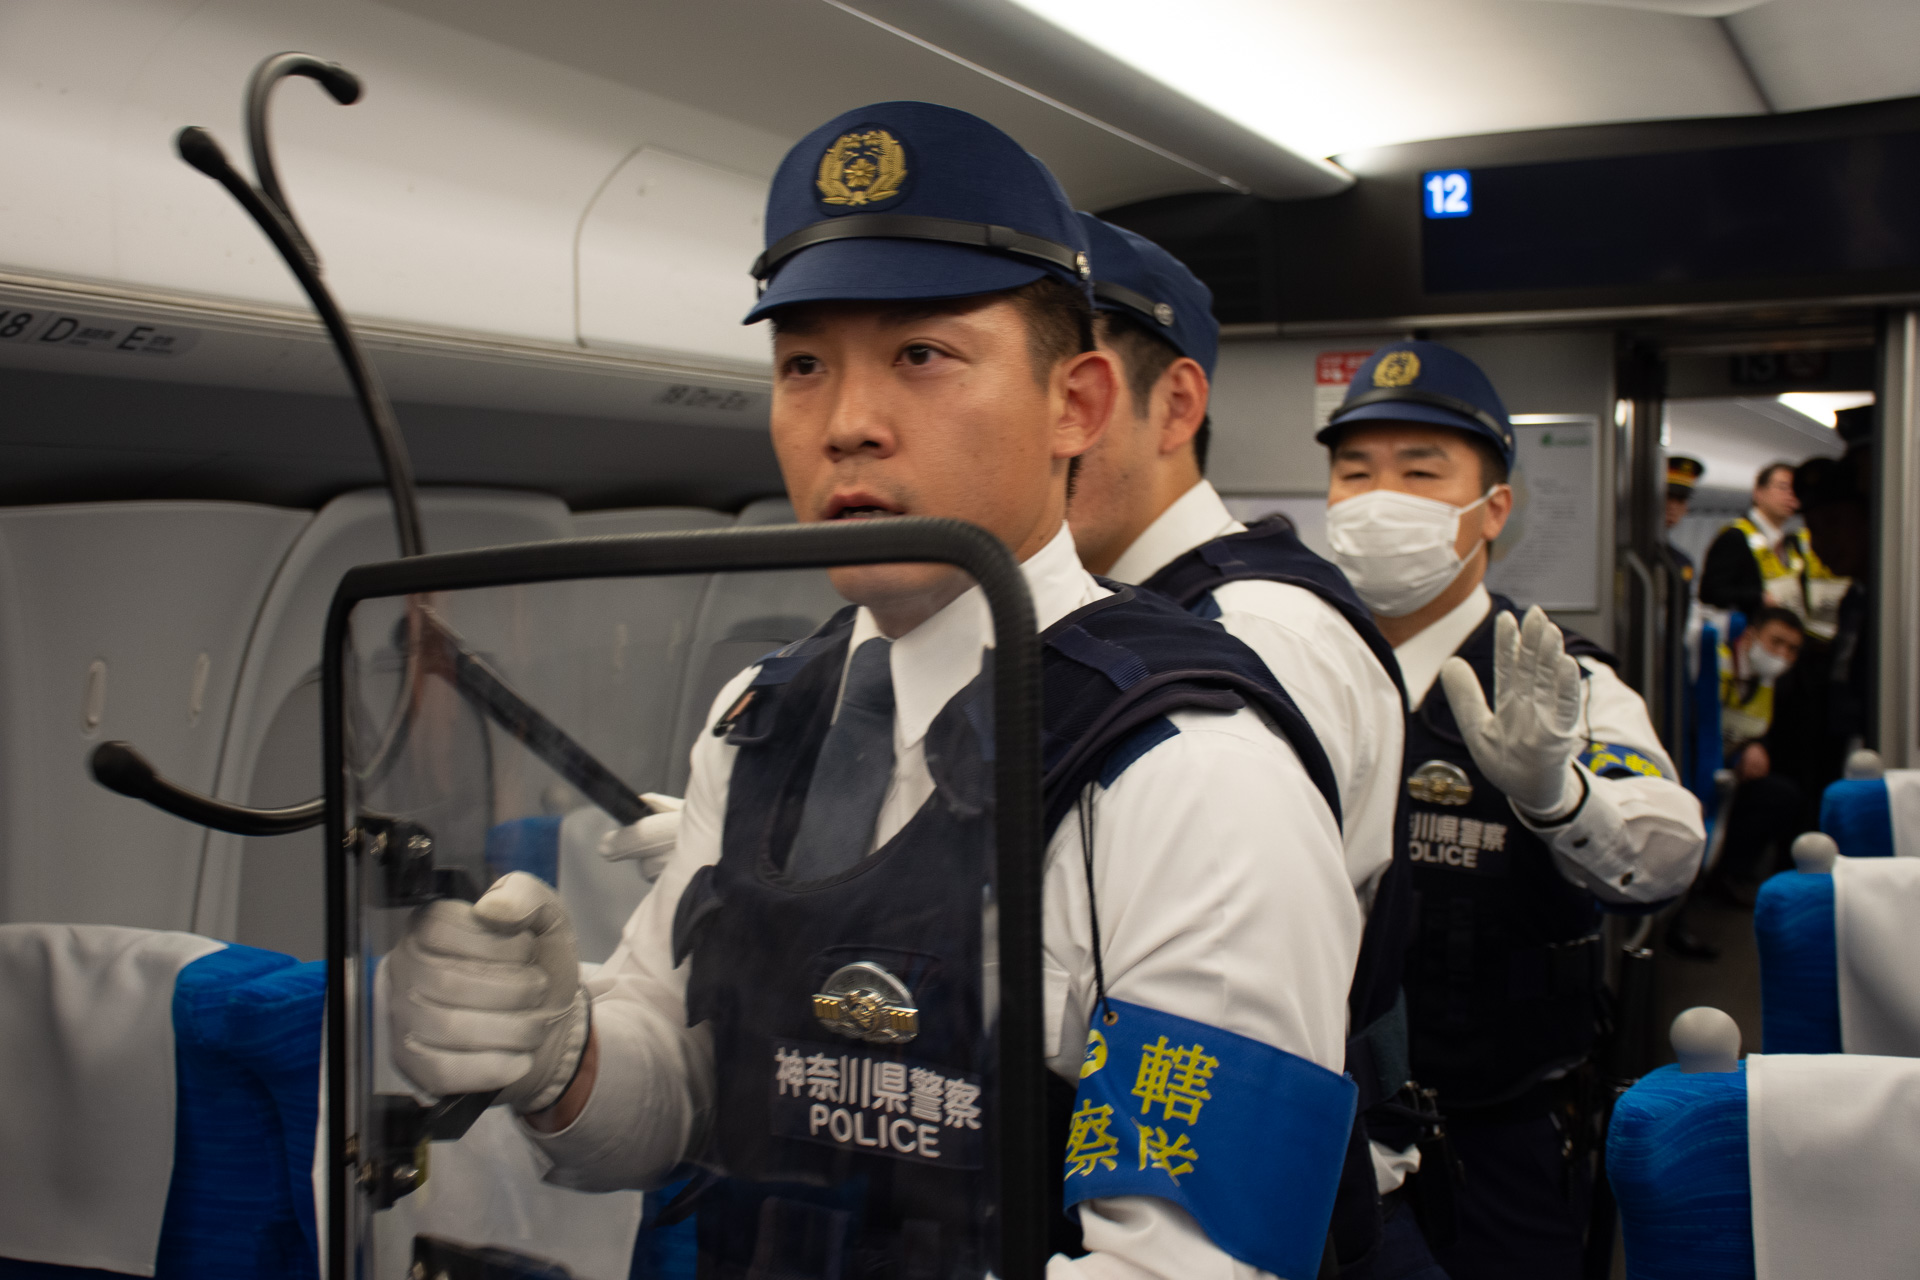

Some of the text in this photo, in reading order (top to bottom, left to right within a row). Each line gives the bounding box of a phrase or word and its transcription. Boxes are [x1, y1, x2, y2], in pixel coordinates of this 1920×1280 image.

[1426, 173, 1469, 213] 12
[40, 317, 79, 343] D
[116, 326, 156, 351] E
[1409, 811, 1508, 852] 川県警察
[1408, 840, 1478, 868] OLICE
[774, 1046, 982, 1130] 神奈川県警察
[809, 1103, 941, 1158] POLICE
